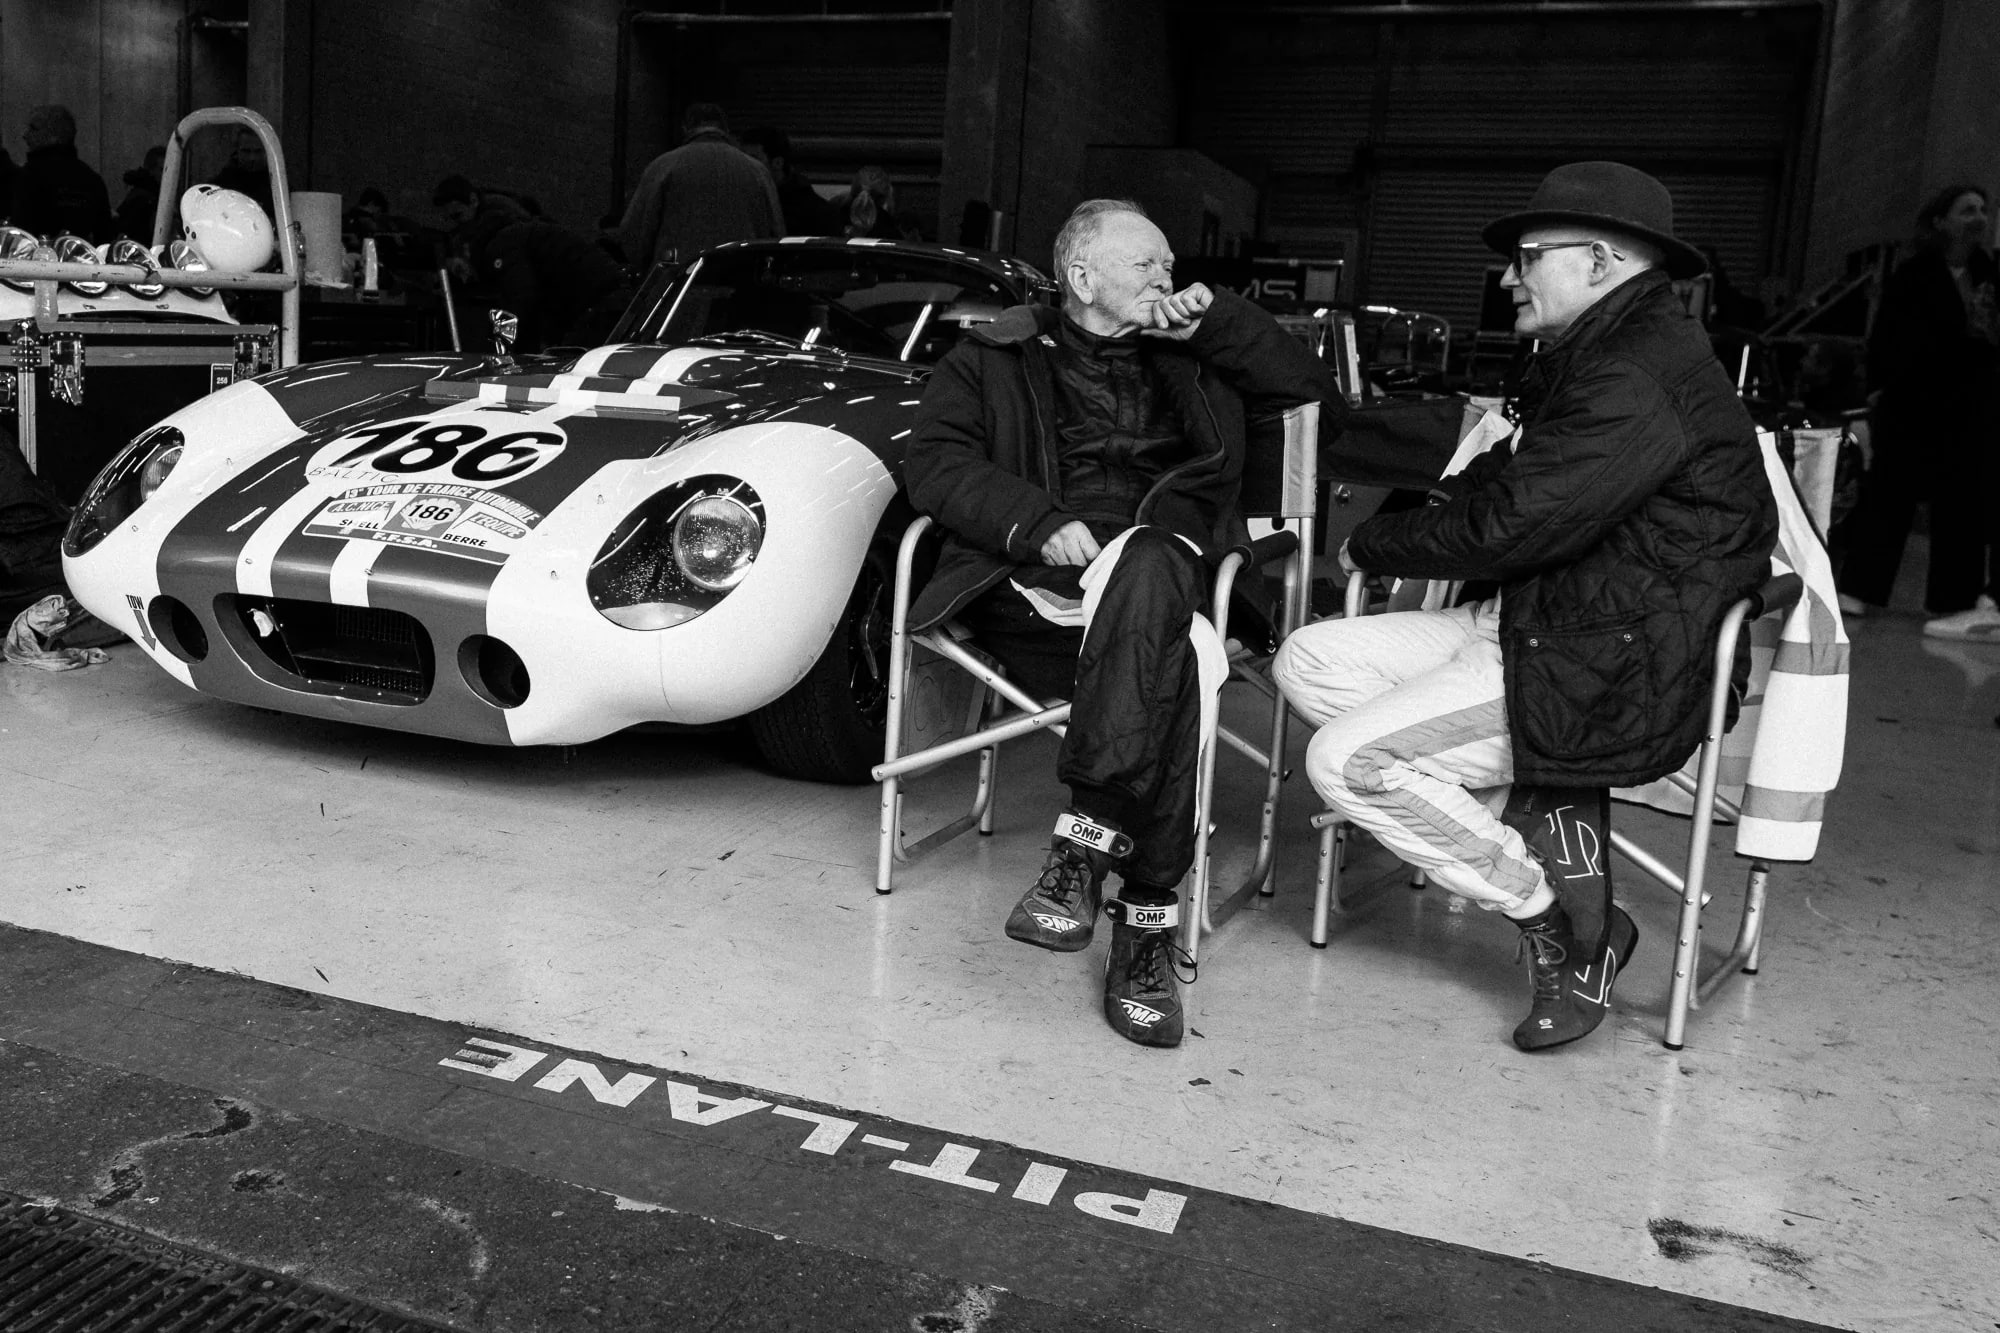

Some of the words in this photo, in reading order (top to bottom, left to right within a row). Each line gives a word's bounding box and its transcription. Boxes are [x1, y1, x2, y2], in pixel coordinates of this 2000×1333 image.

[329, 421, 564, 481] 186
[308, 466, 400, 483] BALTIC
[366, 483, 402, 496] TOUR
[402, 483, 425, 494] DE
[421, 483, 477, 498] FRANCE
[468, 489, 541, 524] AUTOMOBILE
[408, 504, 454, 521] 186
[372, 531, 438, 549] F.F.S.A.
[442, 533, 488, 547] BERRE
[125, 594, 145, 610] TOW
[1070, 822, 1103, 842] OMP
[1135, 911, 1166, 923] OMP
